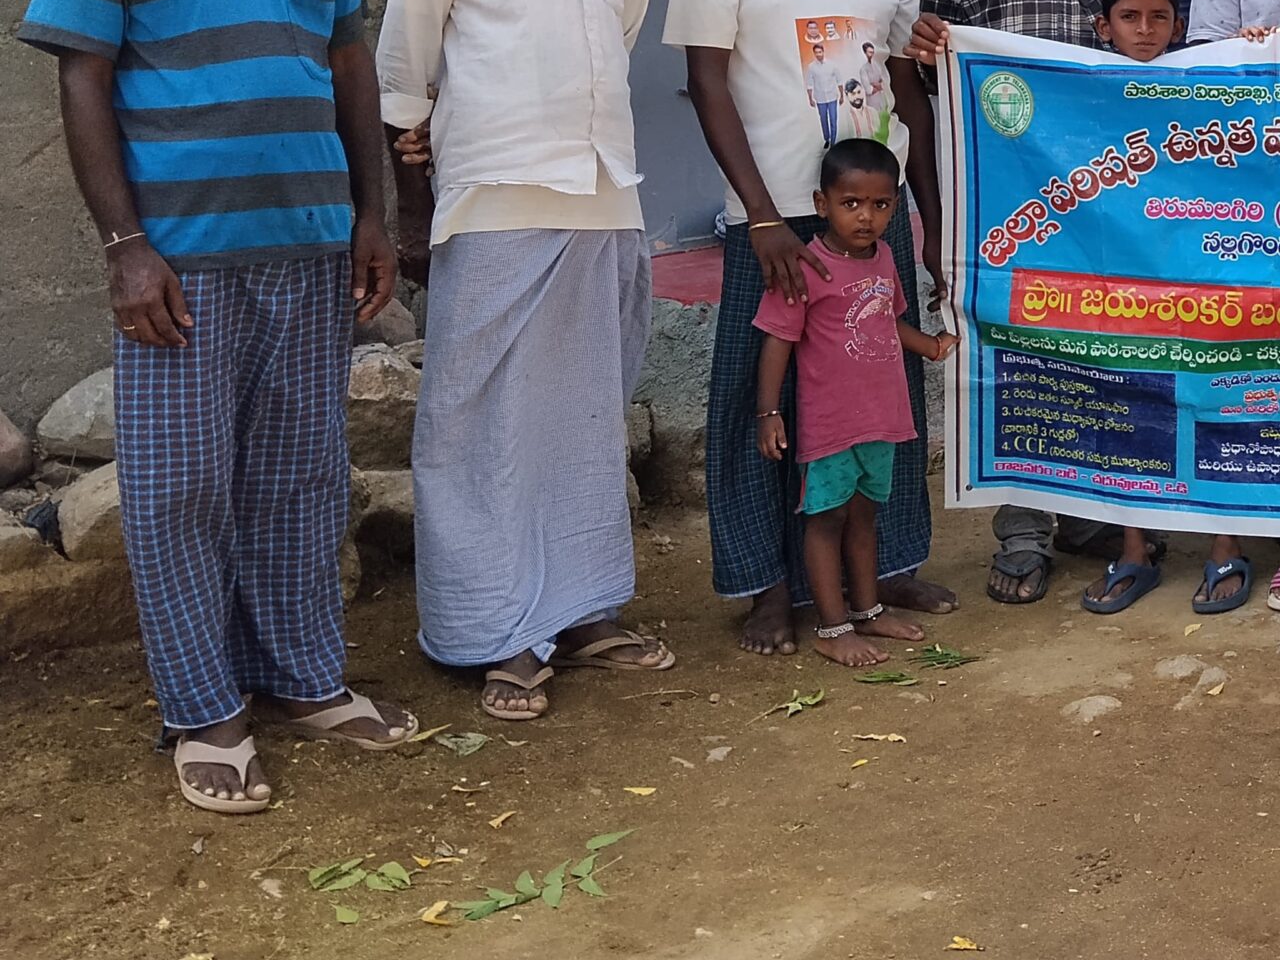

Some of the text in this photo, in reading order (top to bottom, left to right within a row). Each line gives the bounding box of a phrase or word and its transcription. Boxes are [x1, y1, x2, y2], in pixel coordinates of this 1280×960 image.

[1125, 82, 1192, 98] పాఠశాల
[979, 199, 1062, 266] జిల్లా
[1040, 129, 1158, 214] పరిషత్
[1161, 117, 1257, 167] ఉన్నత
[1144, 197, 1264, 222] తిరుమలగిరి
[1080, 287, 1243, 327] జయశంకర్
[1059, 339, 1088, 355] మన
[1090, 341, 1168, 360] పాఠశాలలో
[1169, 345, 1242, 367] చేర్పించండి
[1002, 372, 1011, 382] 1.
[1002, 389, 1011, 399] 2.
[1002, 407, 1011, 416] 3.
[1041, 427, 1047, 436] 3
[1002, 441, 1011, 451] 4.
[1014, 435, 1048, 455] CCE
[1198, 459, 1243, 472] మరియు
